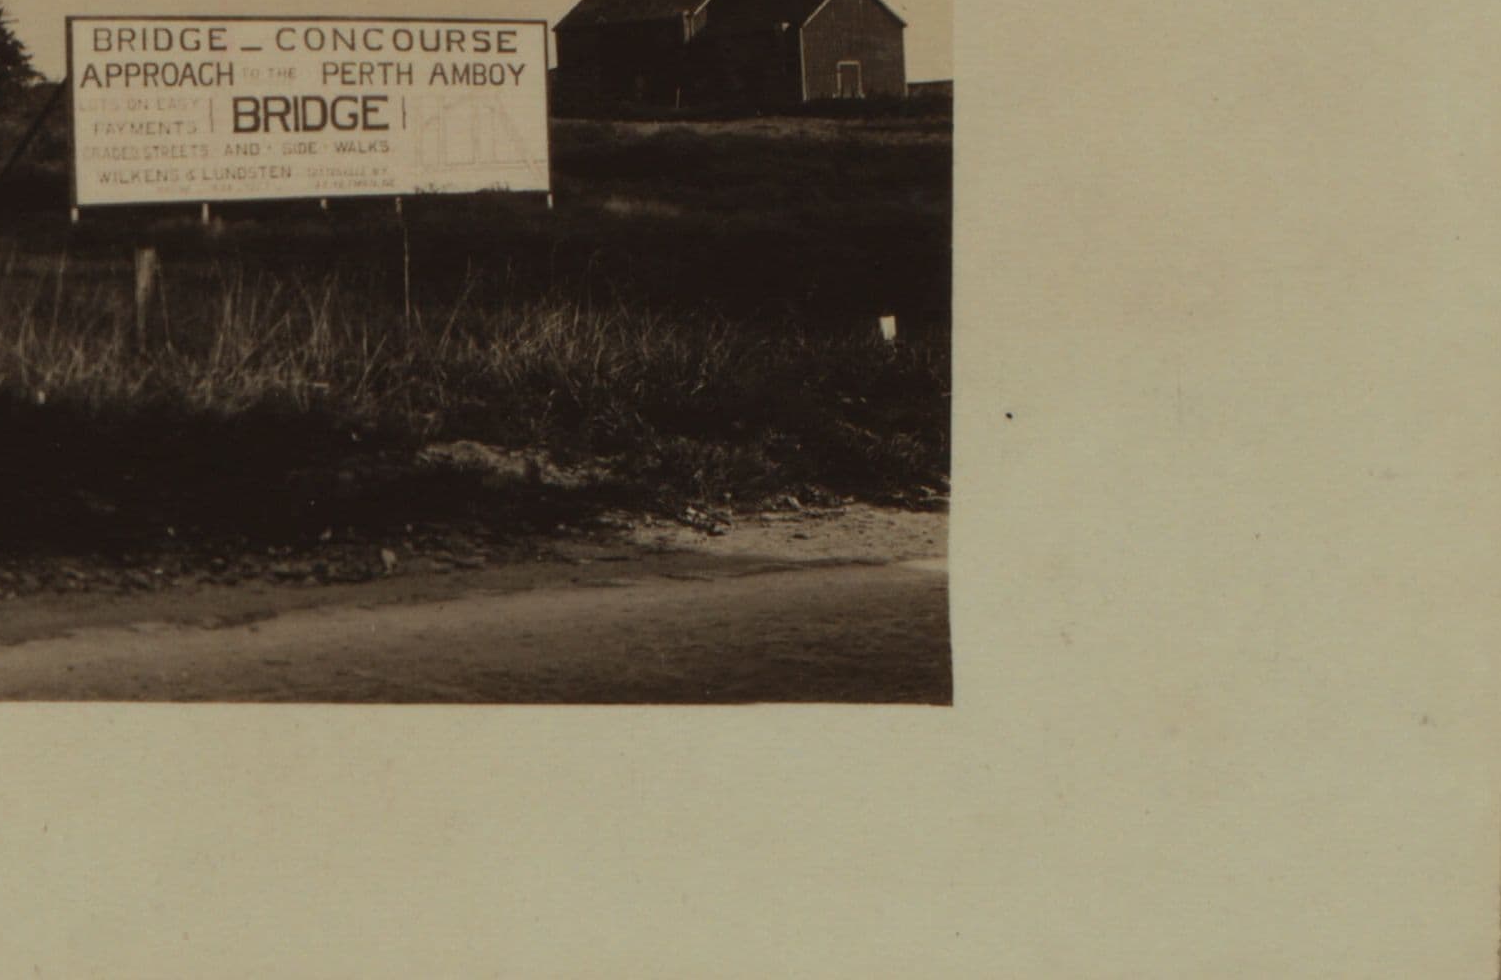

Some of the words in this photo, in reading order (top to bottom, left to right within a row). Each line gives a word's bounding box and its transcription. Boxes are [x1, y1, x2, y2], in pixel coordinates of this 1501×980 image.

[92, 26, 228, 52] BRIDGE
[275, 27, 517, 54] CONCOURSE
[79, 61, 234, 88] APPROACH
[321, 61, 413, 85] PERTH
[429, 61, 526, 86] AMBOY
[232, 95, 390, 133] BRIDGE
[93, 121, 198, 135] PAYMENTS
[224, 142, 260, 156] AND
[281, 141, 318, 155] SIDE
[334, 140, 390, 154] WALKS
